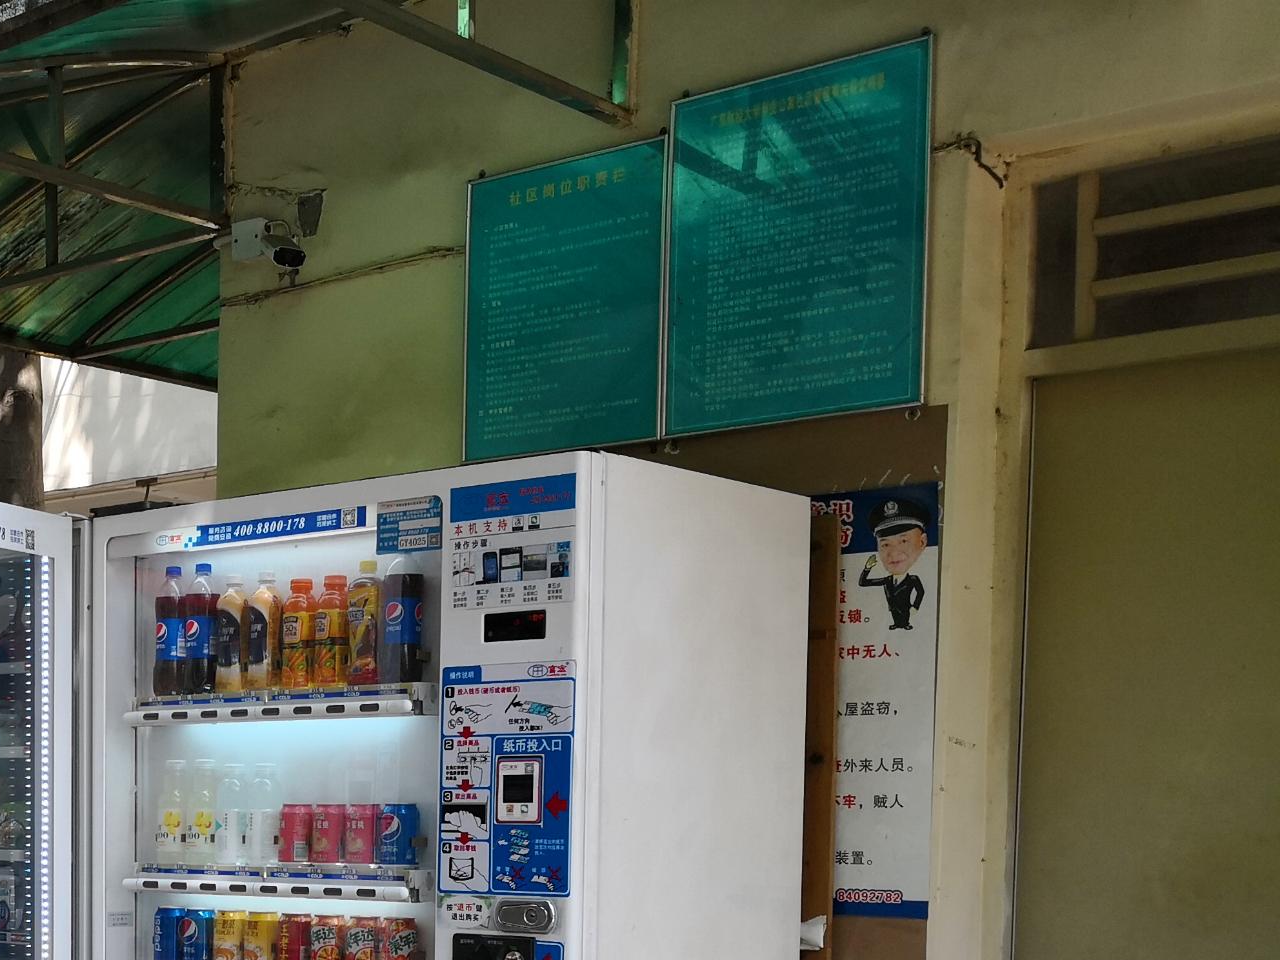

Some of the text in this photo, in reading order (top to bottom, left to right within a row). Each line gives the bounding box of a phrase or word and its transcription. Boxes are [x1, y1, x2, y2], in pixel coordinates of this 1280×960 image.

[233, 516, 307, 537] 400-8800-178
[454, 518, 508, 537] 本机支持
[399, 536, 427, 548] GY4025
[449, 671, 475, 680] 操作说明
[445, 740, 453, 750] 2
[503, 738, 562, 753] 纸币投入口
[444, 792, 451, 801] 3
[443, 843, 451, 852] 4
[836, 887, 904, 905] 84092782
[153, 915, 163, 952] pepsi
